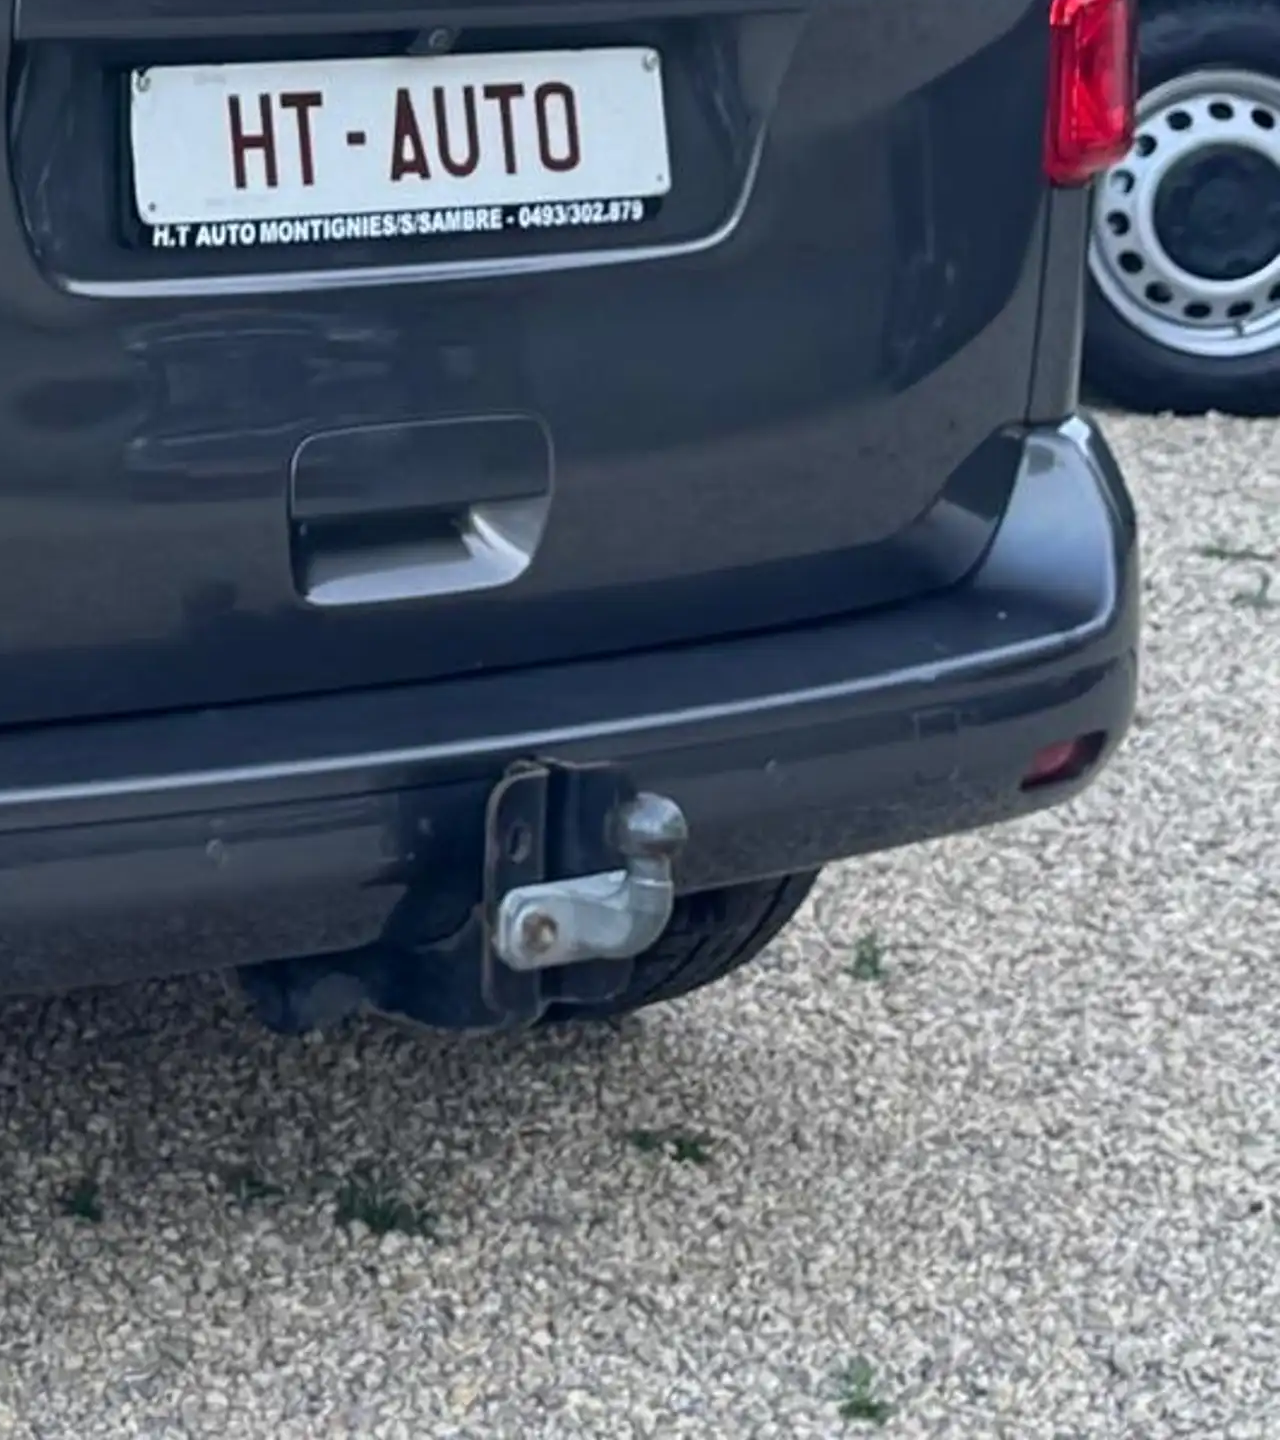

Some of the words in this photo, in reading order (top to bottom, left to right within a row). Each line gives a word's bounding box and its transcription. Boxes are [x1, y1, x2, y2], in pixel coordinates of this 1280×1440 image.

[227, 90, 323, 189] HT
[390, 81, 582, 182] AUTO
[196, 222, 257, 248] AUTO
